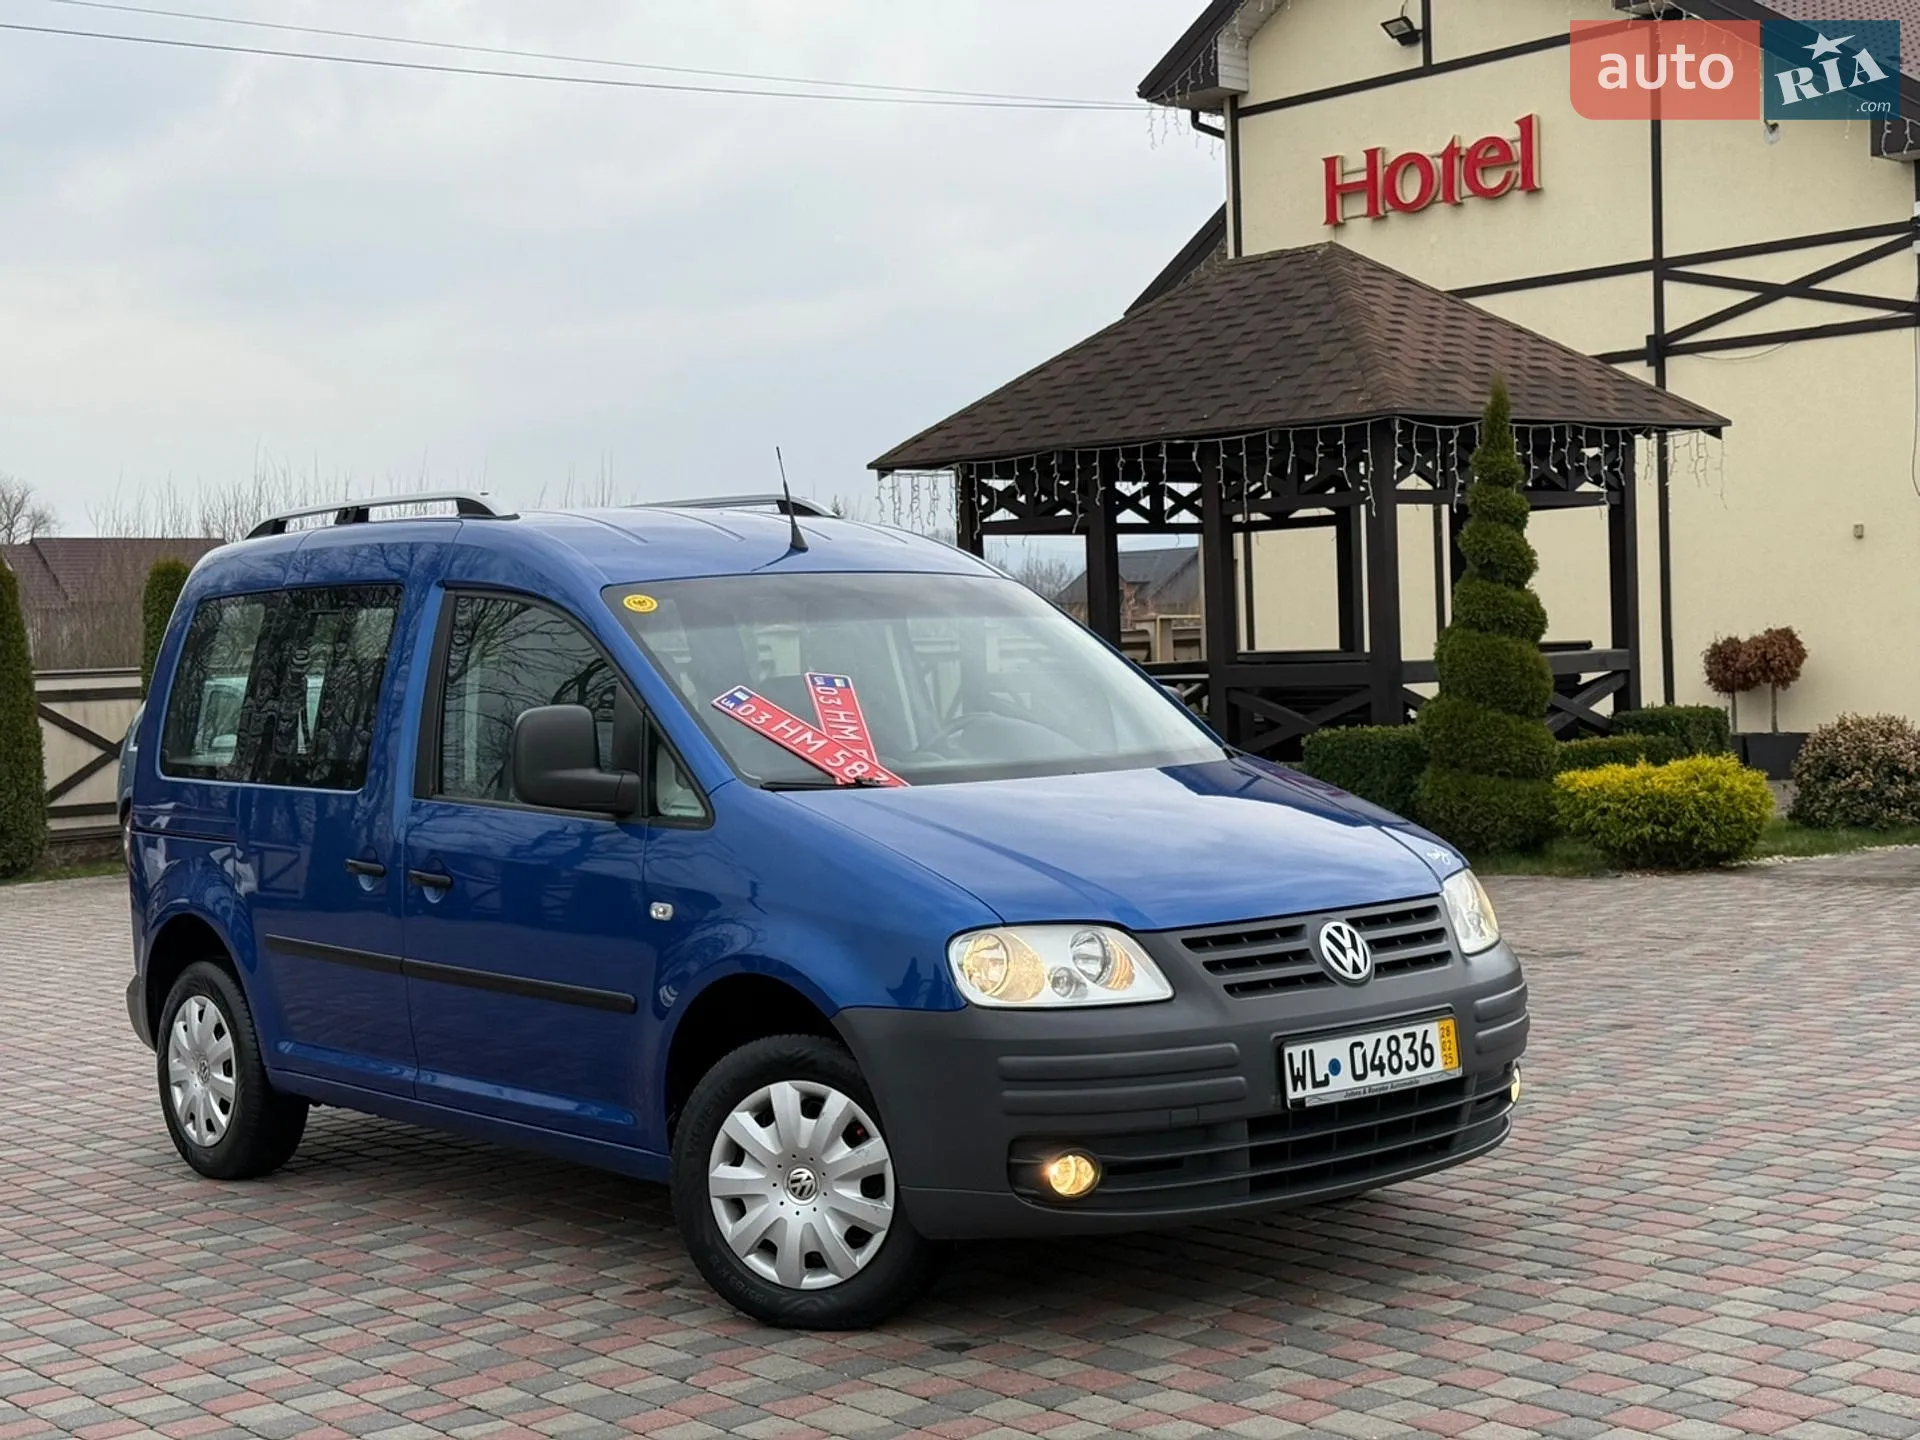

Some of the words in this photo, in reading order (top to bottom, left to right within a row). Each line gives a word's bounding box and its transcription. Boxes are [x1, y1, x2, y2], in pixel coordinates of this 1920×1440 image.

[1322, 113, 1542, 225] Hotel
[737, 703, 772, 725] 03
[771, 719, 828, 754] HM
[1287, 1048, 1330, 1092] WL
[1350, 1029, 1435, 1081] 04836
